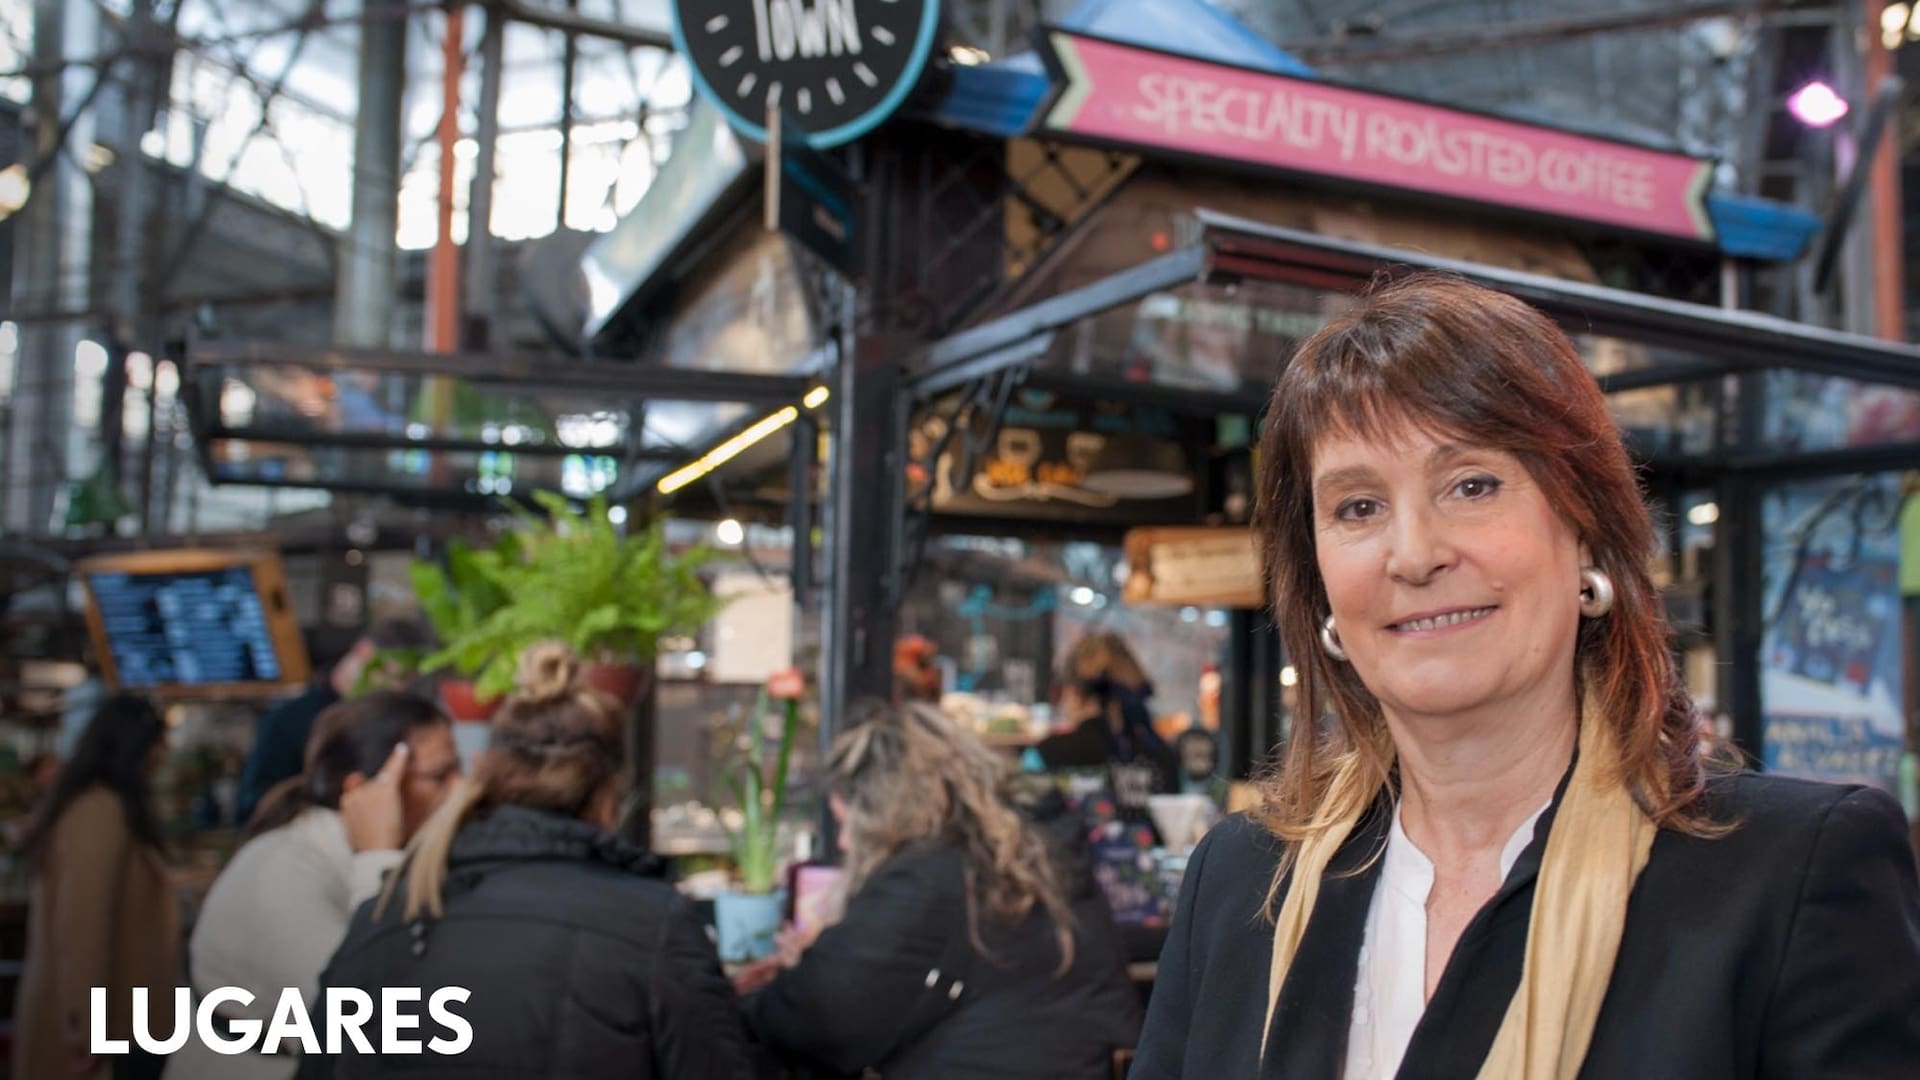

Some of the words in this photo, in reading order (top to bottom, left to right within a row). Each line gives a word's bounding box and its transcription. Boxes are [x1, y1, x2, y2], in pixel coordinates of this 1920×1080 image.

[1132, 73, 1359, 162] SPECIALTY
[1364, 111, 1534, 187] ROASTED
[1537, 148, 1656, 210] COFFEE
